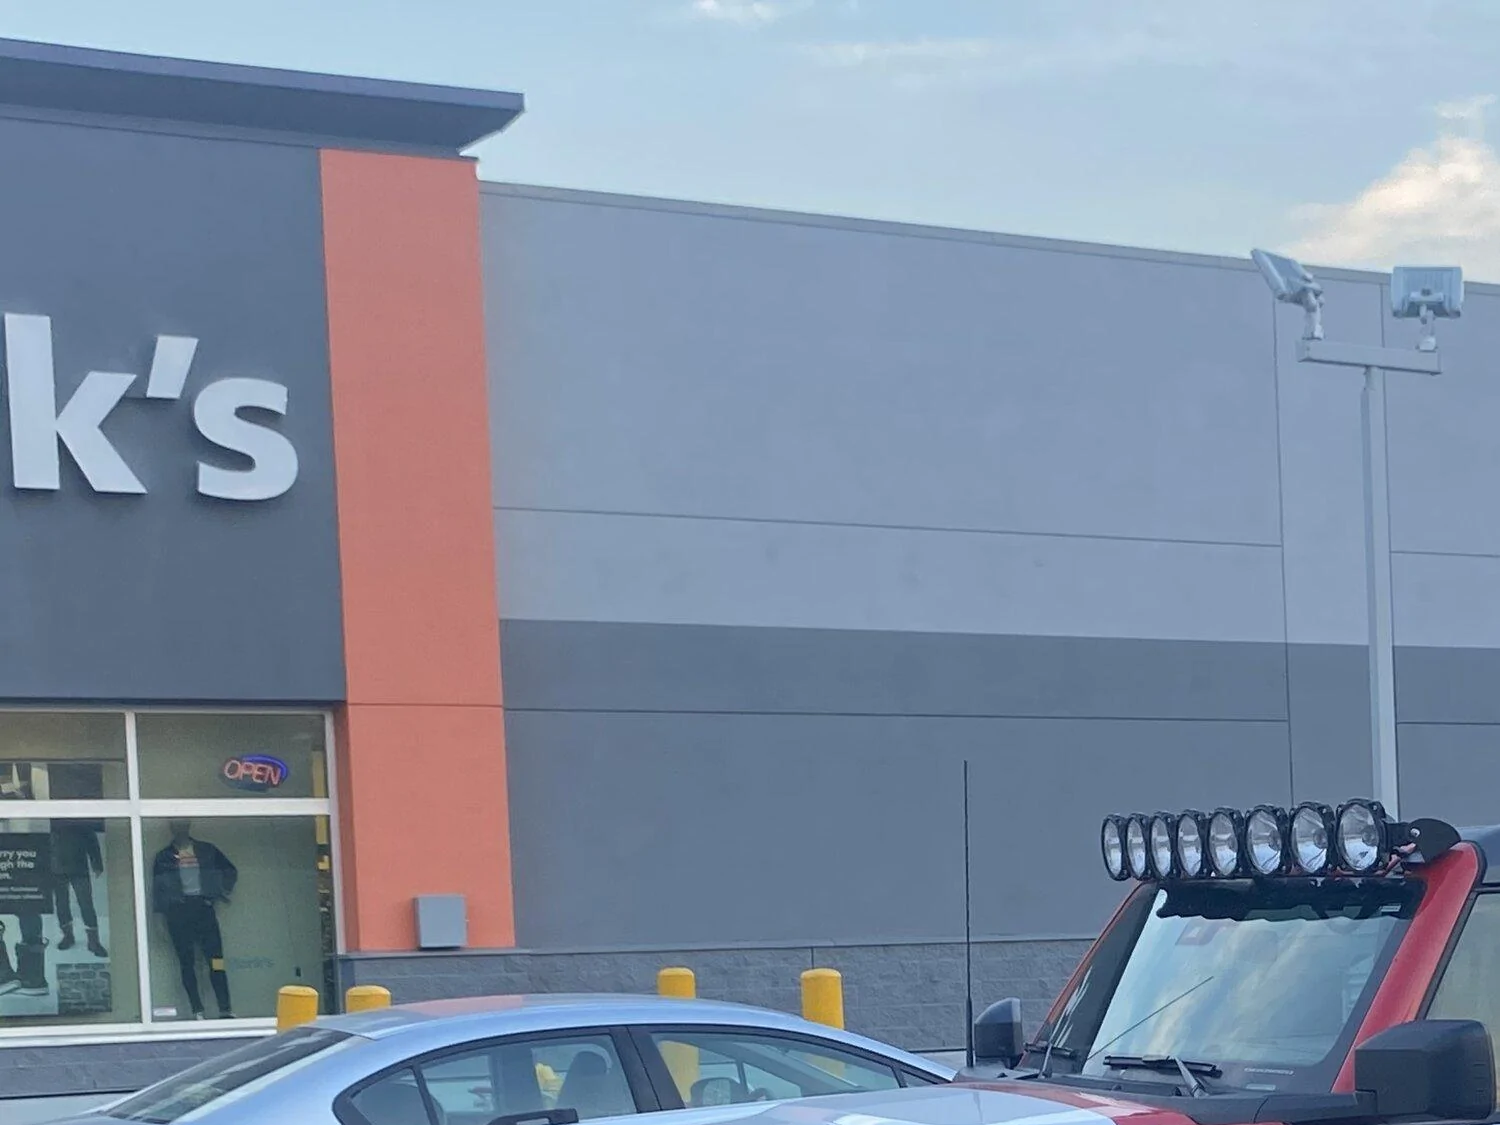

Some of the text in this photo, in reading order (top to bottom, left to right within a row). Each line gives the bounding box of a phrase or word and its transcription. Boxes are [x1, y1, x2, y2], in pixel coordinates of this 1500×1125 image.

[223, 759, 282, 785] OPEN
[16, 850, 37, 860] you
[17, 860, 35, 869] the
